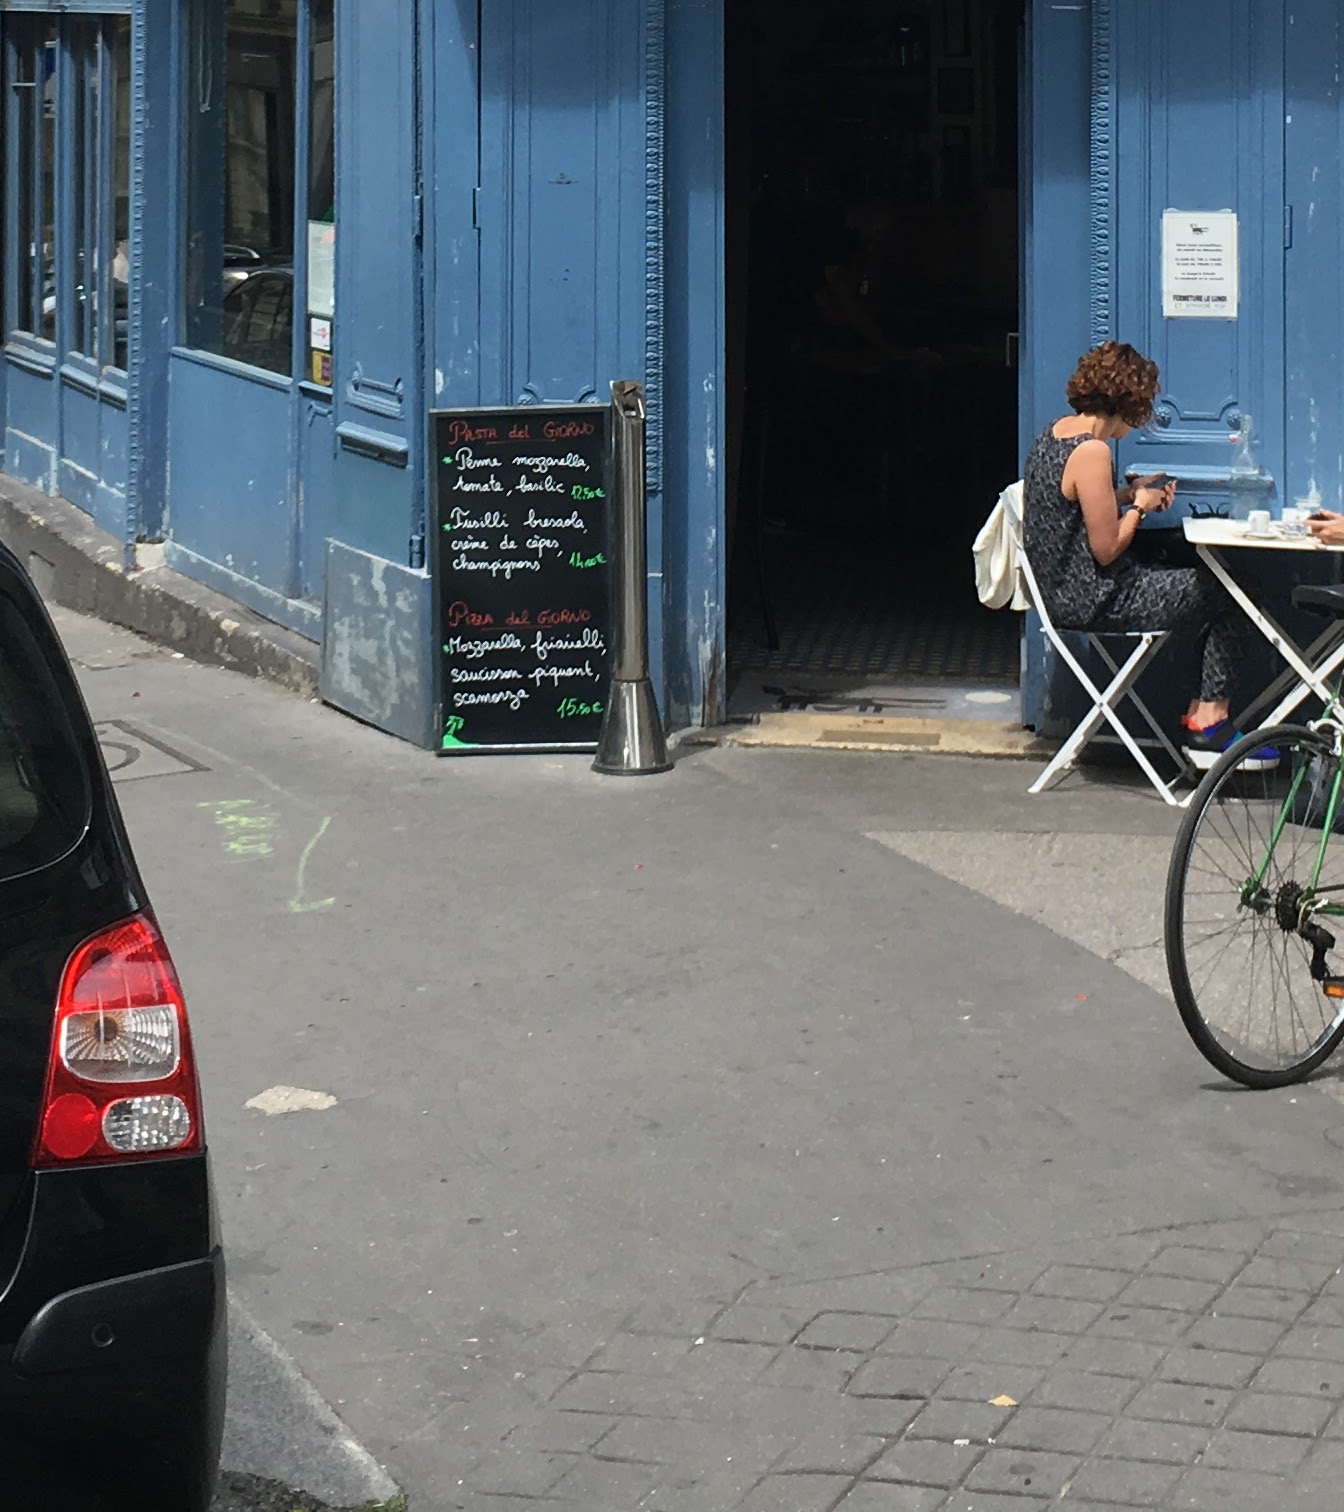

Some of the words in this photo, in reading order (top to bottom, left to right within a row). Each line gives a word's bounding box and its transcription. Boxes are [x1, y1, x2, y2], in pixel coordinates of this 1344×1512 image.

[508, 424, 530, 439] del
[455, 446, 503, 471] Penne
[515, 474, 566, 494] basilic
[450, 506, 510, 530] Fusilli
[451, 534, 490, 551] crème
[499, 533, 518, 550] de
[452, 553, 541, 580] champignons
[505, 609, 531, 625] del
[450, 666, 523, 683] saucisson
[453, 689, 530, 711] scamorza
